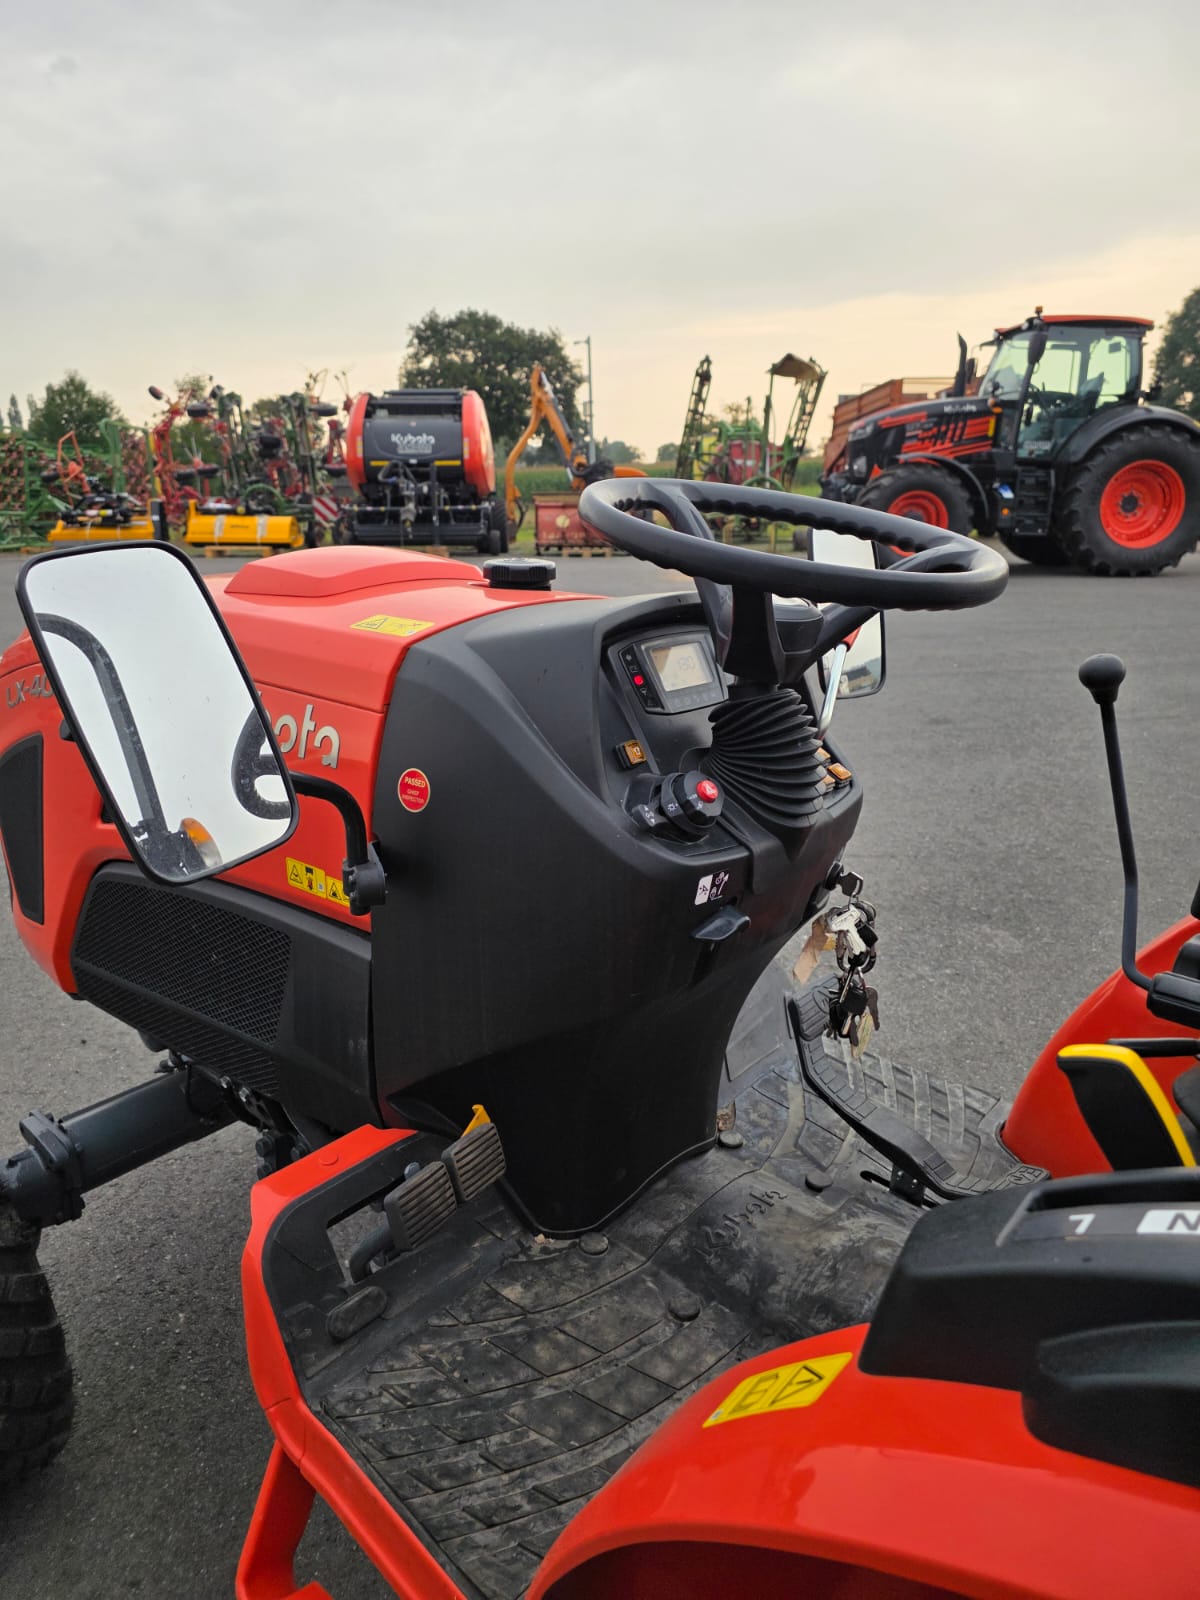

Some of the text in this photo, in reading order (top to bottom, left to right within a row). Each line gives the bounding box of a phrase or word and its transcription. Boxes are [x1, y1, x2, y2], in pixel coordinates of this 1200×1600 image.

[390, 433, 435, 447] Kubota
[257, 691, 340, 769] ota
[404, 776, 426, 788] PASSED
[1166, 1212, 1200, 1231] N
